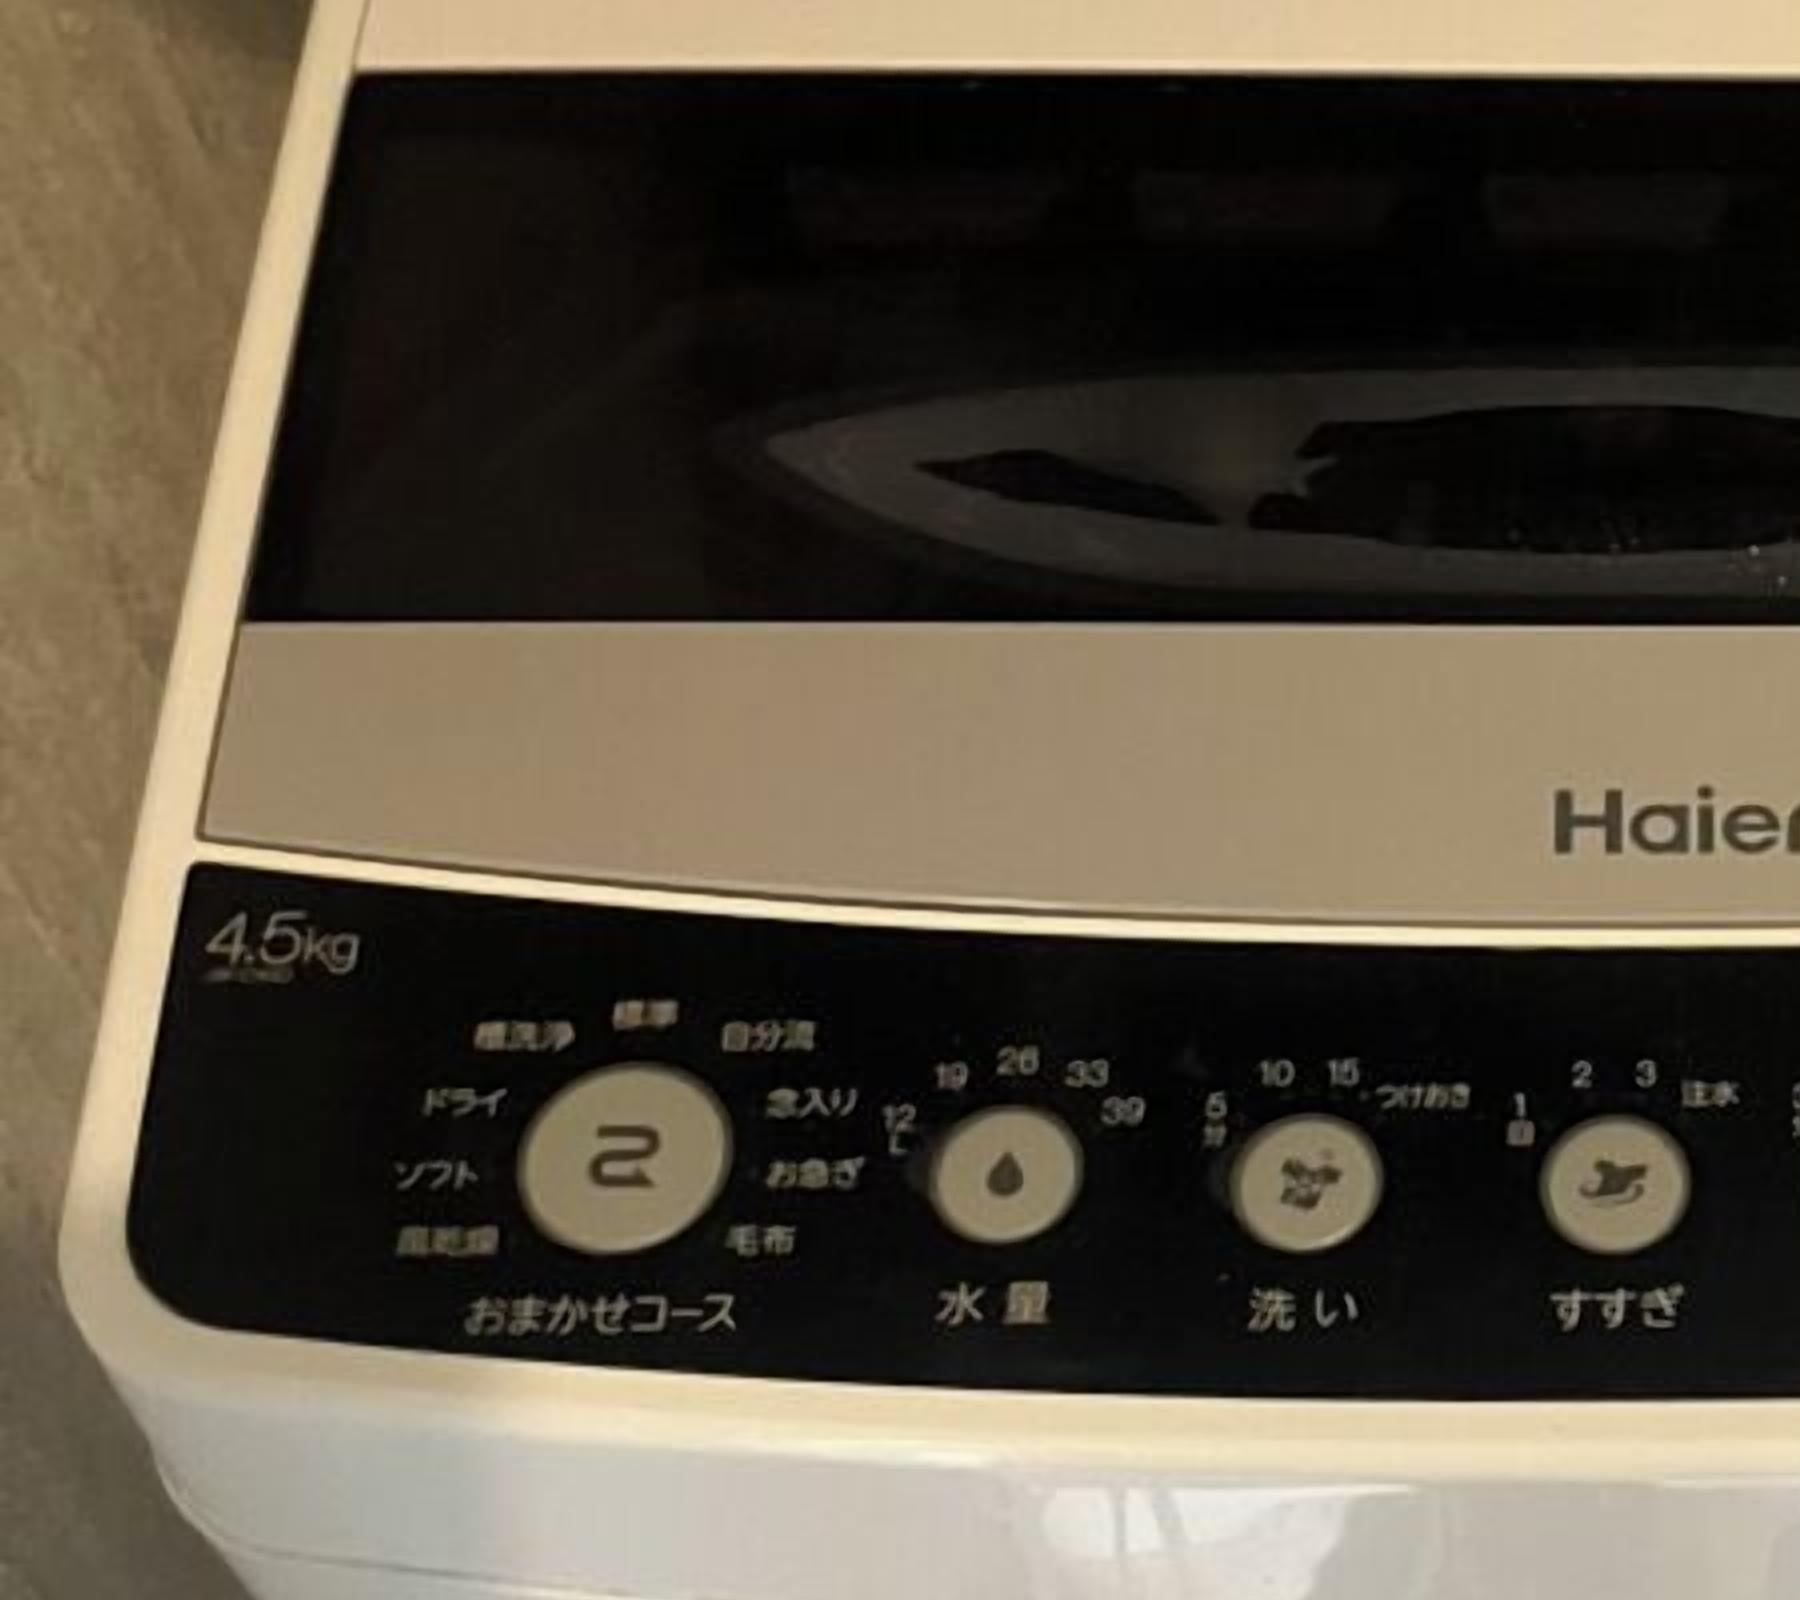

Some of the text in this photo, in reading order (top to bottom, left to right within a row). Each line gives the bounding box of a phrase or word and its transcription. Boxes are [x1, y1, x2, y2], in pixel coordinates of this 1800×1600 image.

[205, 911, 359, 974] 4.5kg
[1260, 1059, 1295, 1087] 10
[1328, 1058, 1360, 1086] 15
[1572, 1060, 1592, 1088] 2
[1636, 1059, 1657, 1087] 3
[423, 1088, 507, 1116] ドライ
[1514, 1093, 1526, 1117] 1
[396, 1160, 478, 1189] ソフト
[726, 1225, 795, 1256] 毛布
[465, 1293, 736, 1335] おまかせコース
[936, 1281, 1049, 1325] 水量
[1248, 1288, 1358, 1331] 洗い
[1550, 1285, 1684, 1330] すすぎ
